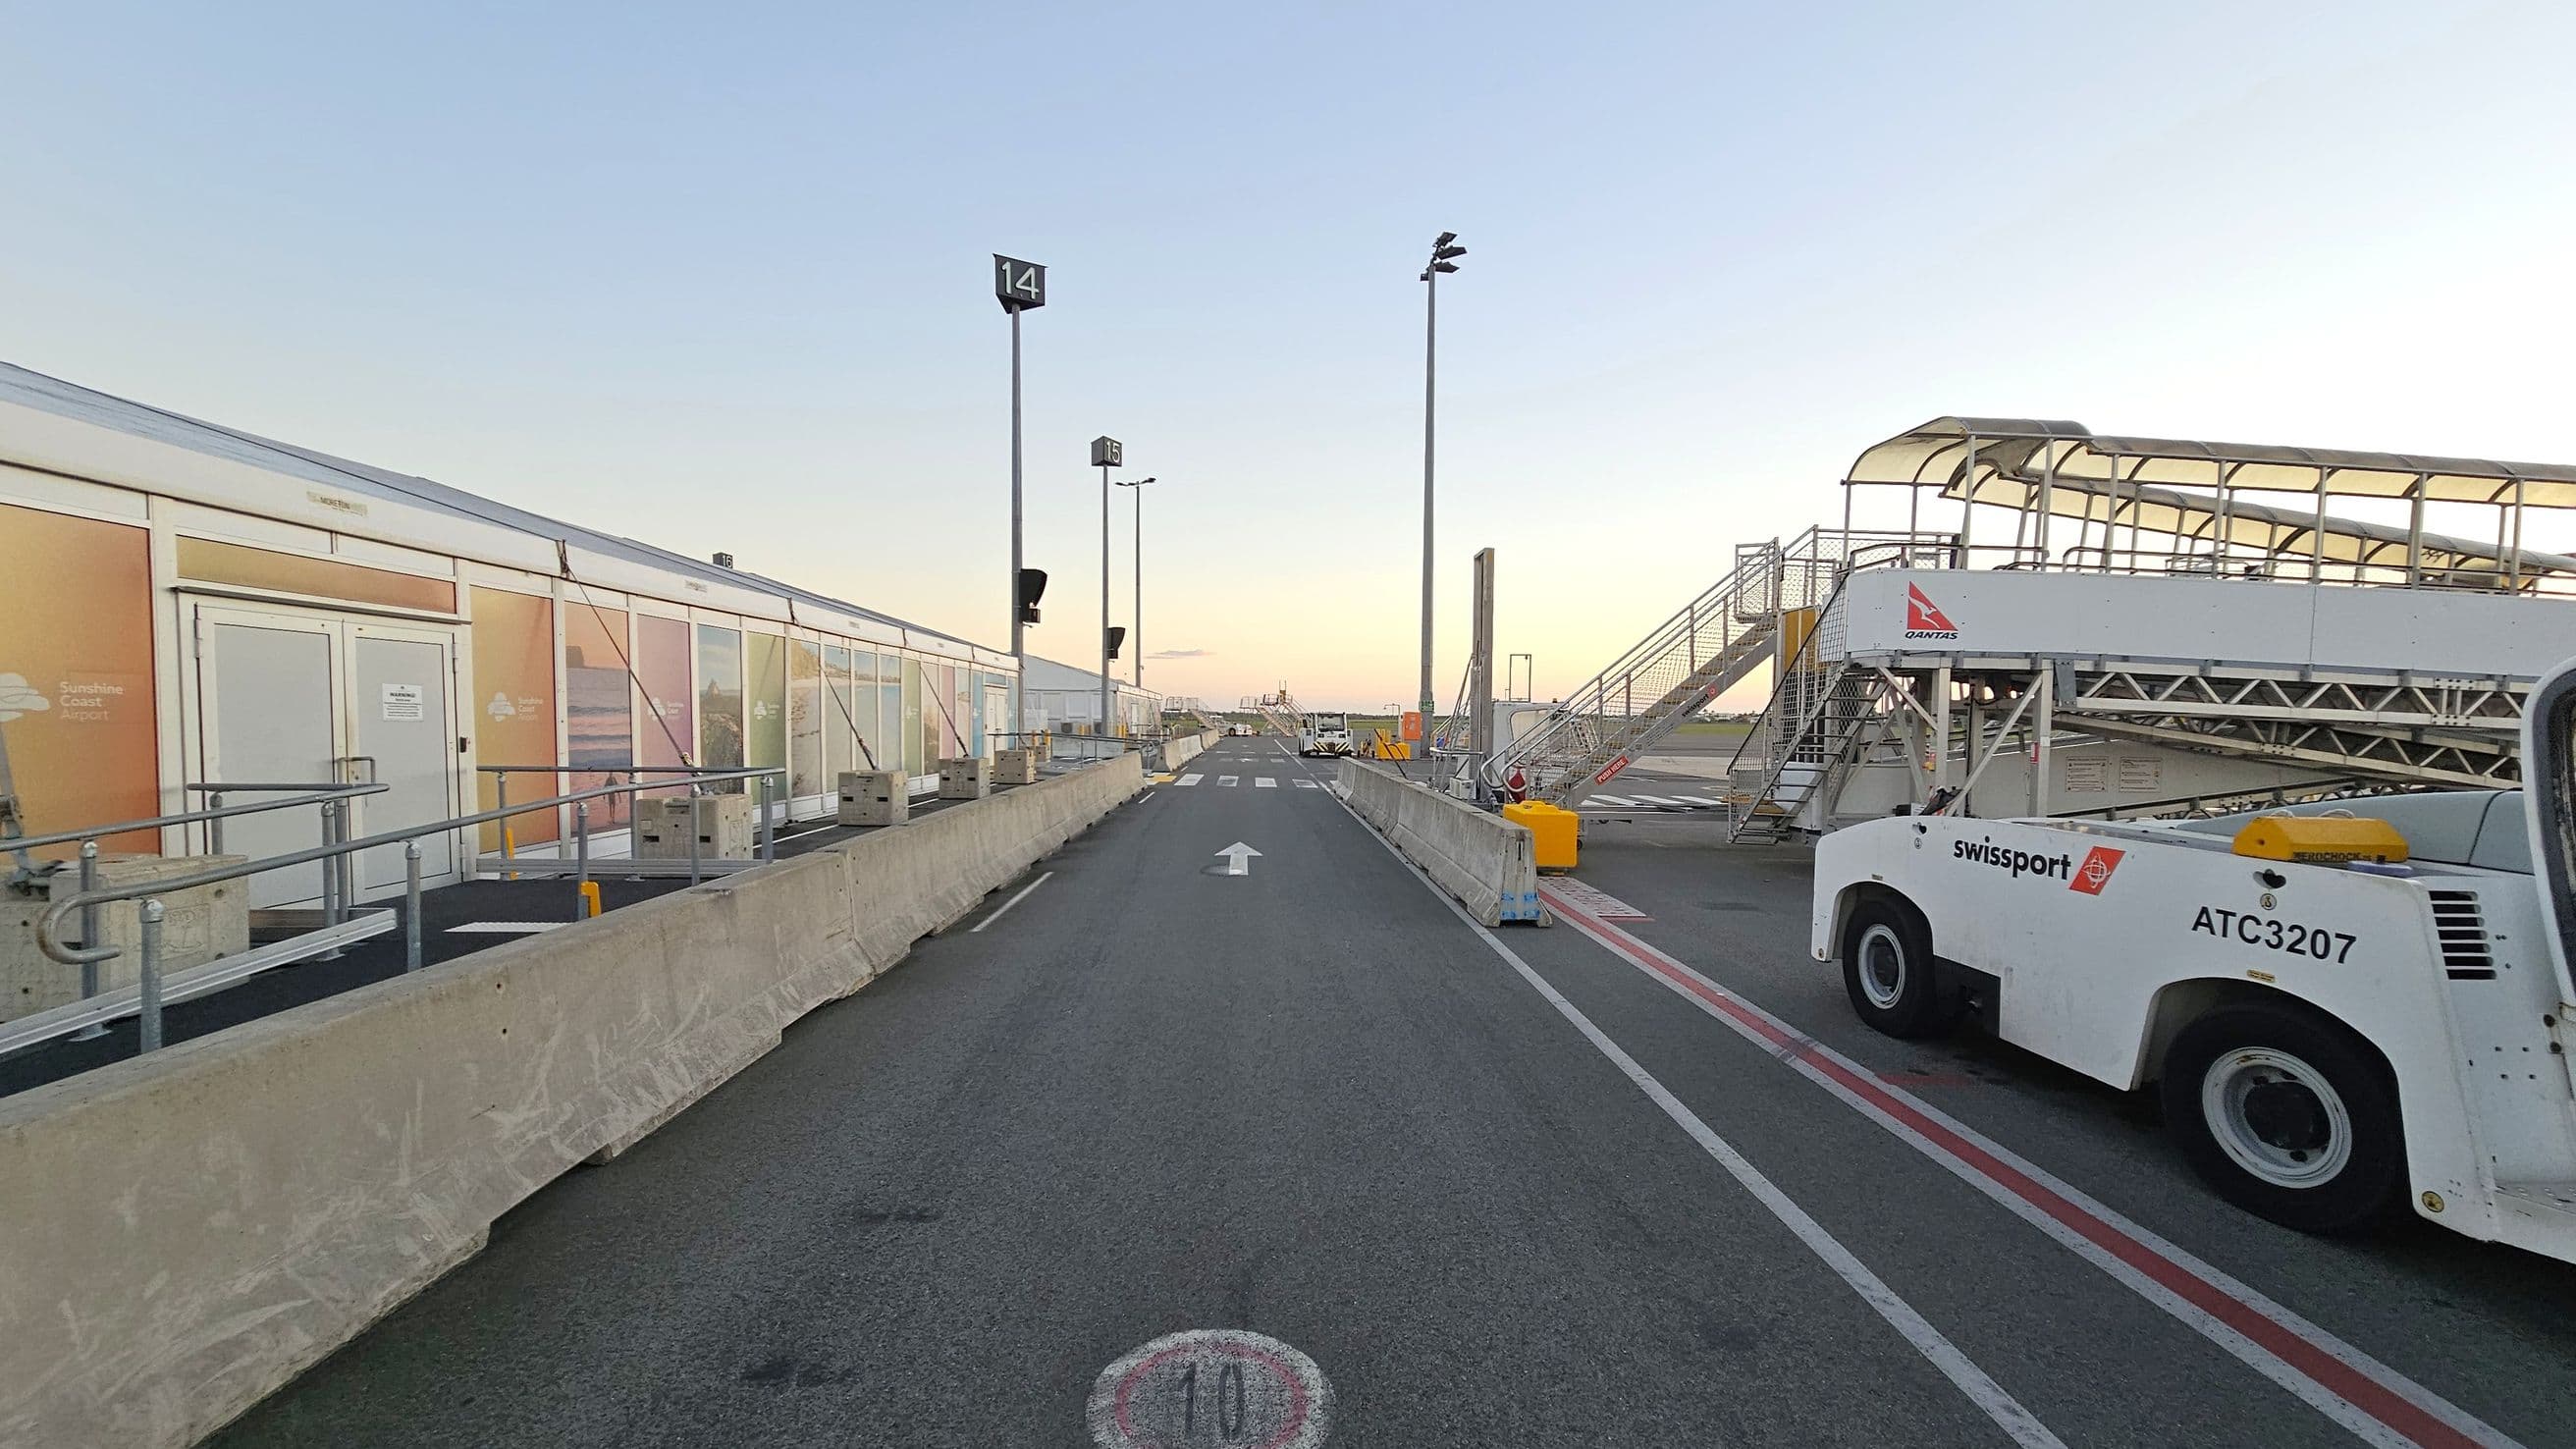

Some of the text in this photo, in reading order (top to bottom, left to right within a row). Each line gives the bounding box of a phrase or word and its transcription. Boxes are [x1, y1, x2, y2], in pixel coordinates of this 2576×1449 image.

[1001, 261, 1040, 300] 14
[1106, 441, 1120, 463] 15
[722, 555, 732, 568] 16
[1905, 630, 1959, 640] QANTAS
[59, 681, 124, 694] Sunshine
[59, 694, 103, 707] Coast
[1681, 693, 1709, 718] swissport
[60, 708, 109, 723] Airport
[1596, 758, 1626, 783] PUSH HERE
[1953, 835, 2071, 881] swissport
[2191, 905, 2357, 964] ATC3207
[1177, 1360, 1247, 1440] 10
